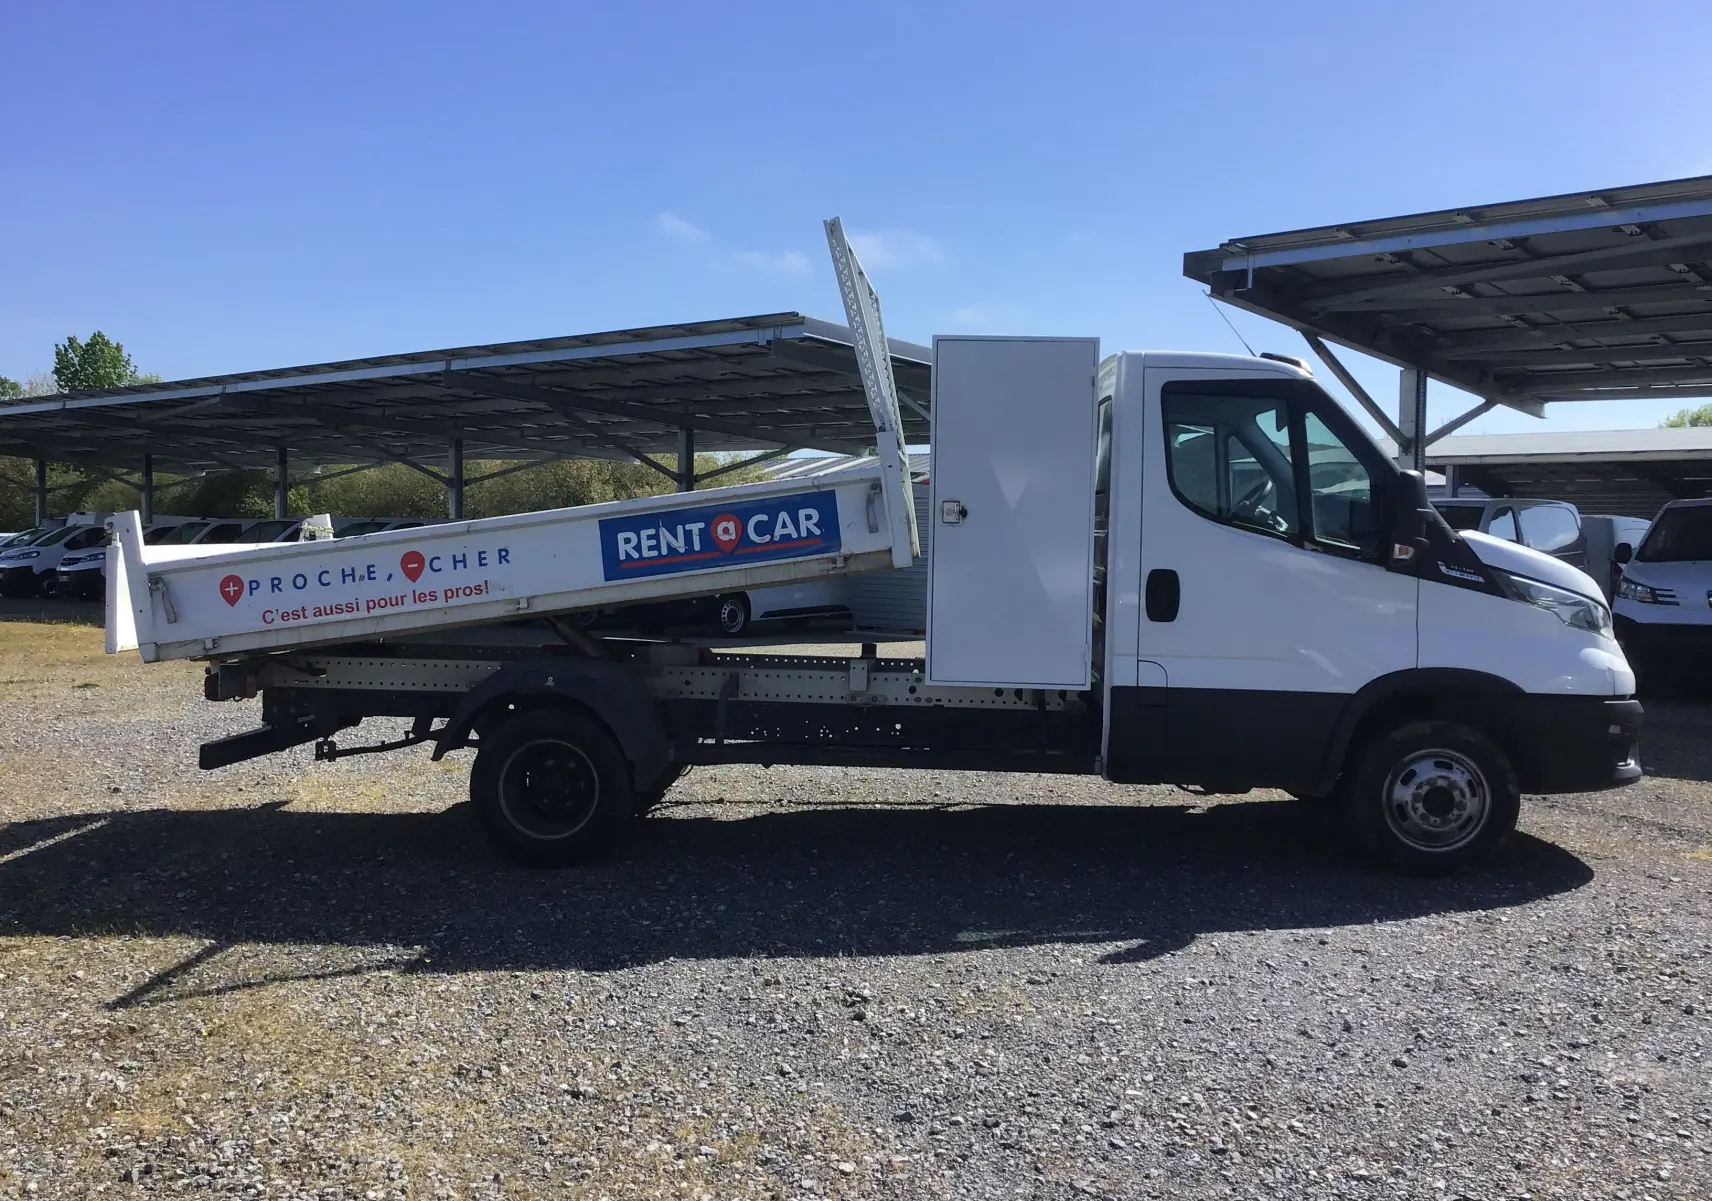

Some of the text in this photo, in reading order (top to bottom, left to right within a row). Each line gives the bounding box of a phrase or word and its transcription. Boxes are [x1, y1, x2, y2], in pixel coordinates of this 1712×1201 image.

[616, 508, 822, 561] RENT a CAR
[248, 564, 393, 596] PROCHE,
[428, 548, 510, 573] CHER
[261, 579, 490, 625] C'est aussi pour les pros!
